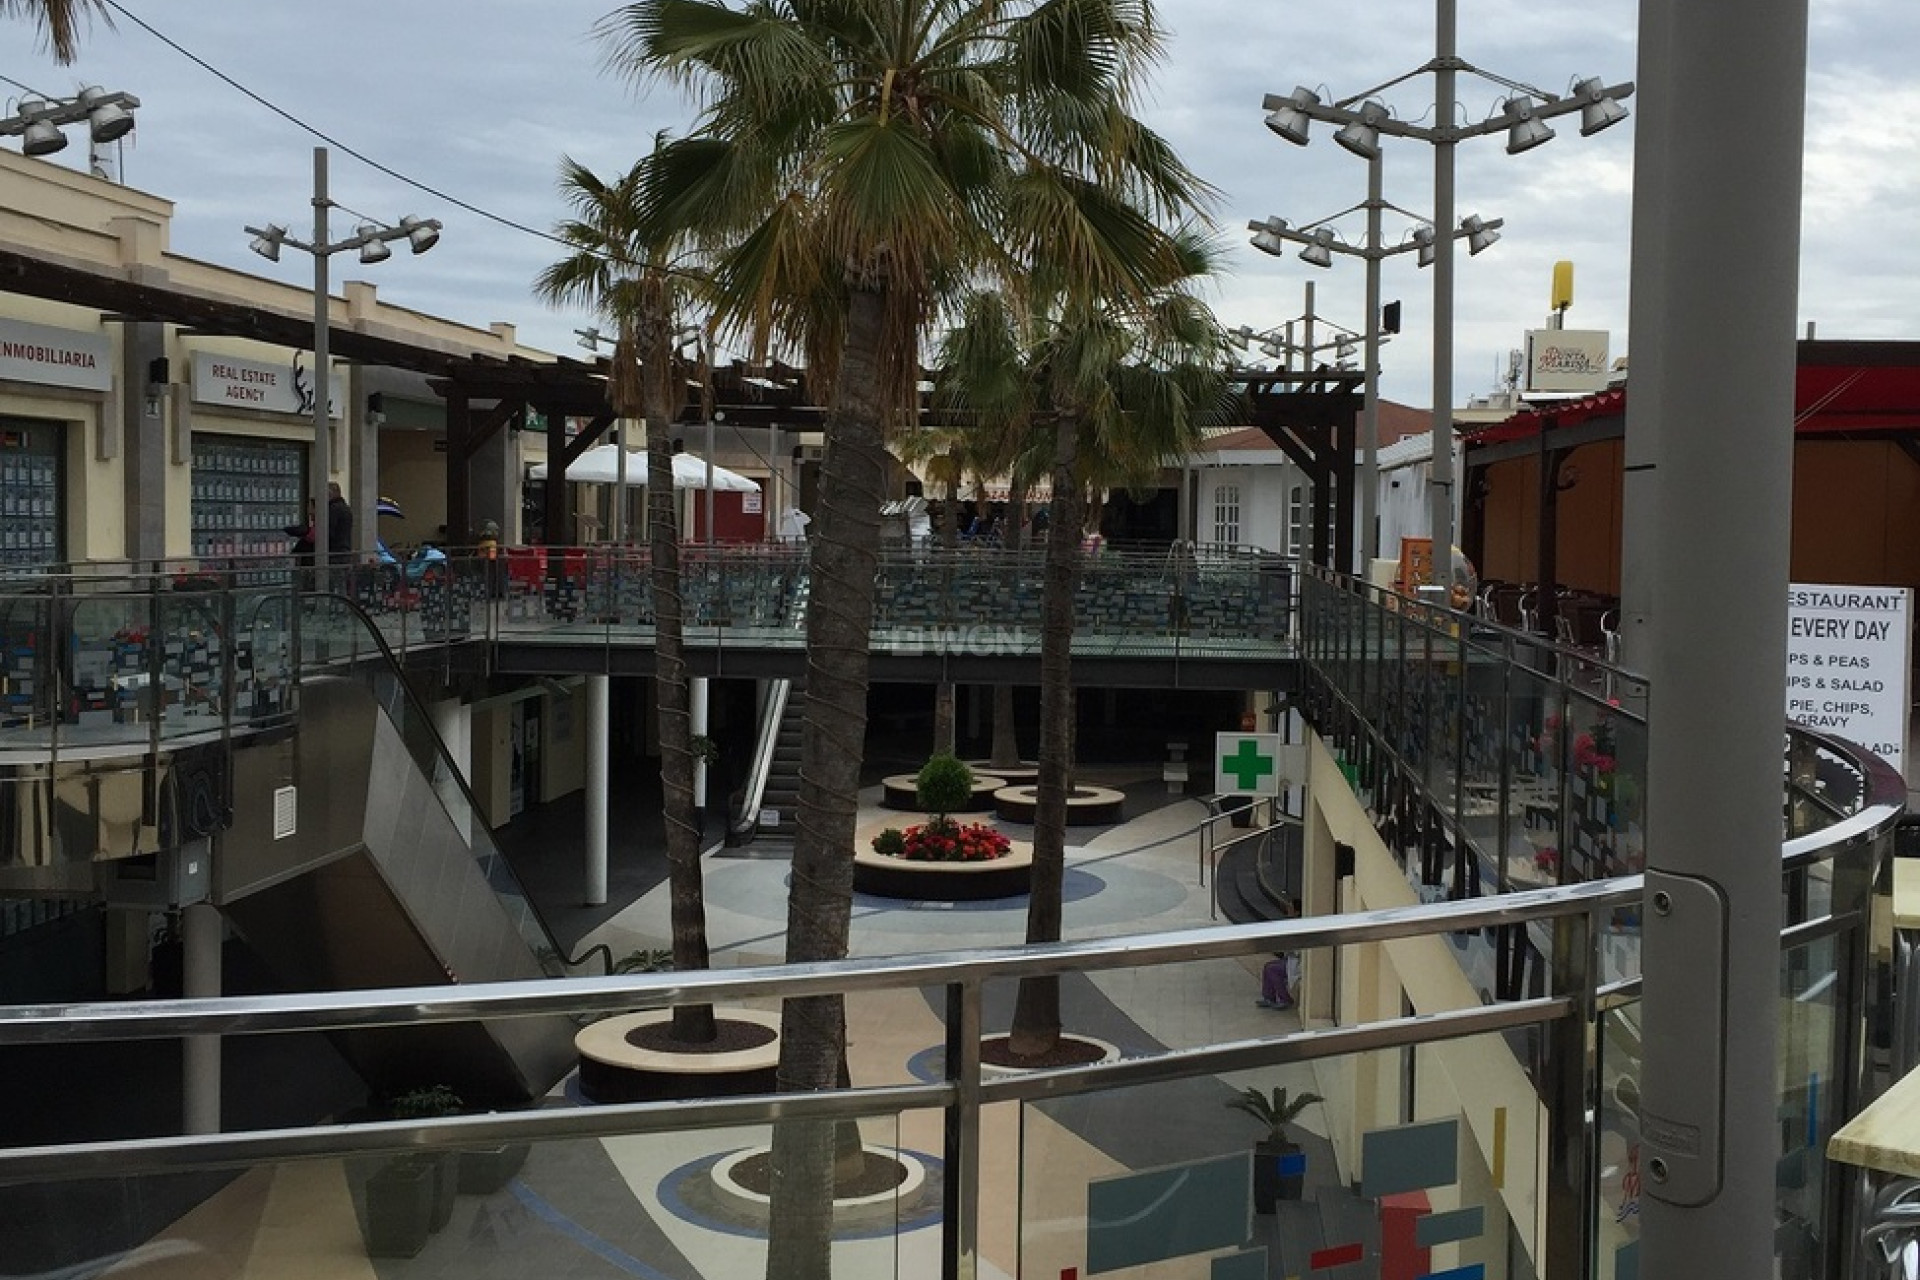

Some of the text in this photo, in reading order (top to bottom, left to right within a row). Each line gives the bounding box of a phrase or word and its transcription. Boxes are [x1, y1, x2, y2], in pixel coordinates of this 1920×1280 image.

[213, 365, 277, 386] REAL ESTATE
[226, 385, 265, 402] AGENCY
[1792, 617, 1891, 641] EVERY DAY
[1789, 653, 1870, 669] PS & PEAS
[1816, 678, 1826, 689] &
[1831, 678, 1884, 692] SALAD
[1790, 700, 1874, 716] PIE, CHIPS,
[1796, 713, 1850, 728] GRAVY
